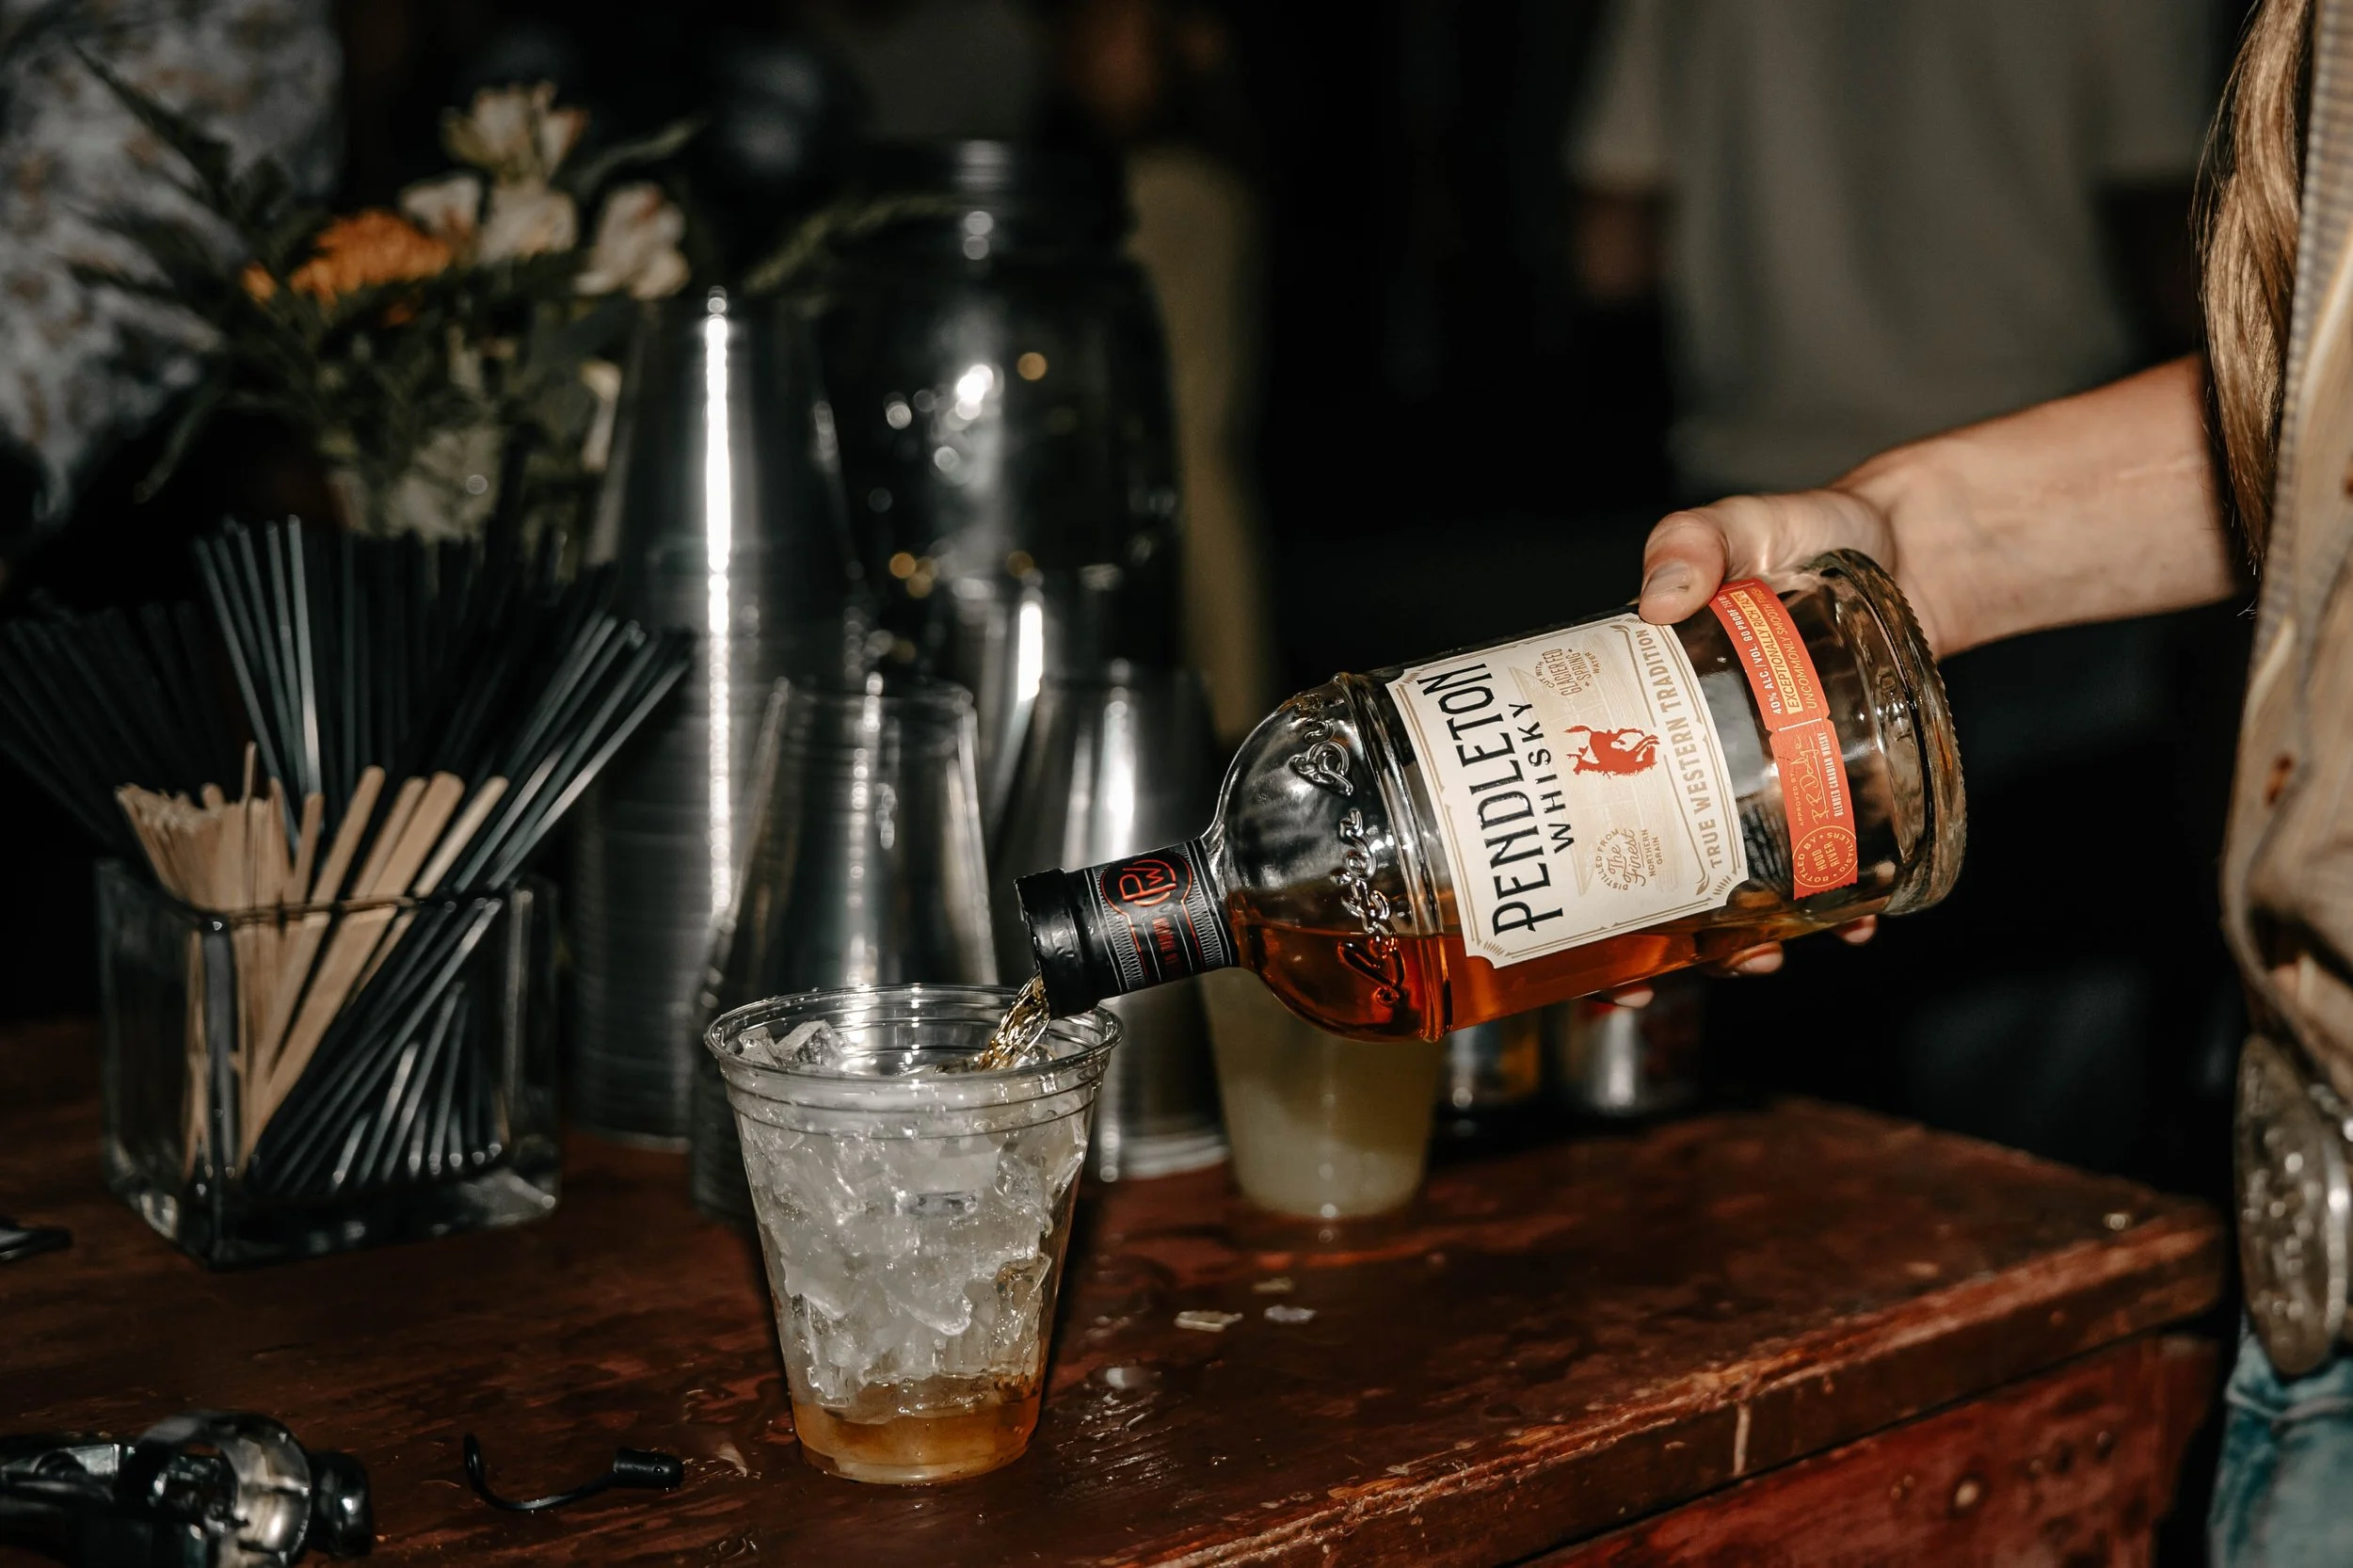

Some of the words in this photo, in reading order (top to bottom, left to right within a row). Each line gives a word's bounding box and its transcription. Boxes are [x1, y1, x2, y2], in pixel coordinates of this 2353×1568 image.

[1726, 607, 1747, 631] PROOF
[1747, 607, 1766, 627] RICH
[1762, 603, 1788, 635] SMOOTH
[1740, 630, 1753, 642] 80
[1535, 661, 1545, 677] WITH
[1542, 648, 1563, 664] FED
[1566, 652, 1592, 681] SPRING
[1585, 651, 1600, 674] WATER
[1758, 628, 1800, 708] EXCEPTIONALLY
[1539, 678, 1555, 688] CUT
[1548, 661, 1582, 696] GLACIER
[1636, 630, 1682, 713] TRADITION
[1782, 636, 1817, 709] UNCOMMONLY
[1768, 692, 1782, 714] 40%
[1817, 731, 1831, 757] WHISKY
[1508, 703, 1575, 855] WHISKY
[1666, 716, 1712, 815] WESTERN
[1824, 757, 1839, 789] CANADIAN
[1417, 663, 1563, 936] PENDLETON
[1792, 786, 1804, 826] APPROVED
[1831, 789, 1844, 817] BLENDED
[1597, 828, 1619, 853] FROM
[1641, 829, 1656, 877] NORTHERN
[1652, 837, 1663, 865] GRAIN
[1698, 818, 1722, 870] TRUE
[1803, 837, 1816, 850] BY
[1824, 840, 1840, 867] RIVER
[1827, 832, 1854, 872] DISTILLERS
[1607, 844, 1624, 874] The
[1621, 828, 1646, 887] Finest
[1798, 854, 1830, 883] BOTTLED
[1812, 849, 1827, 872] HOOD
[1595, 856, 1628, 890] DISTILLED
